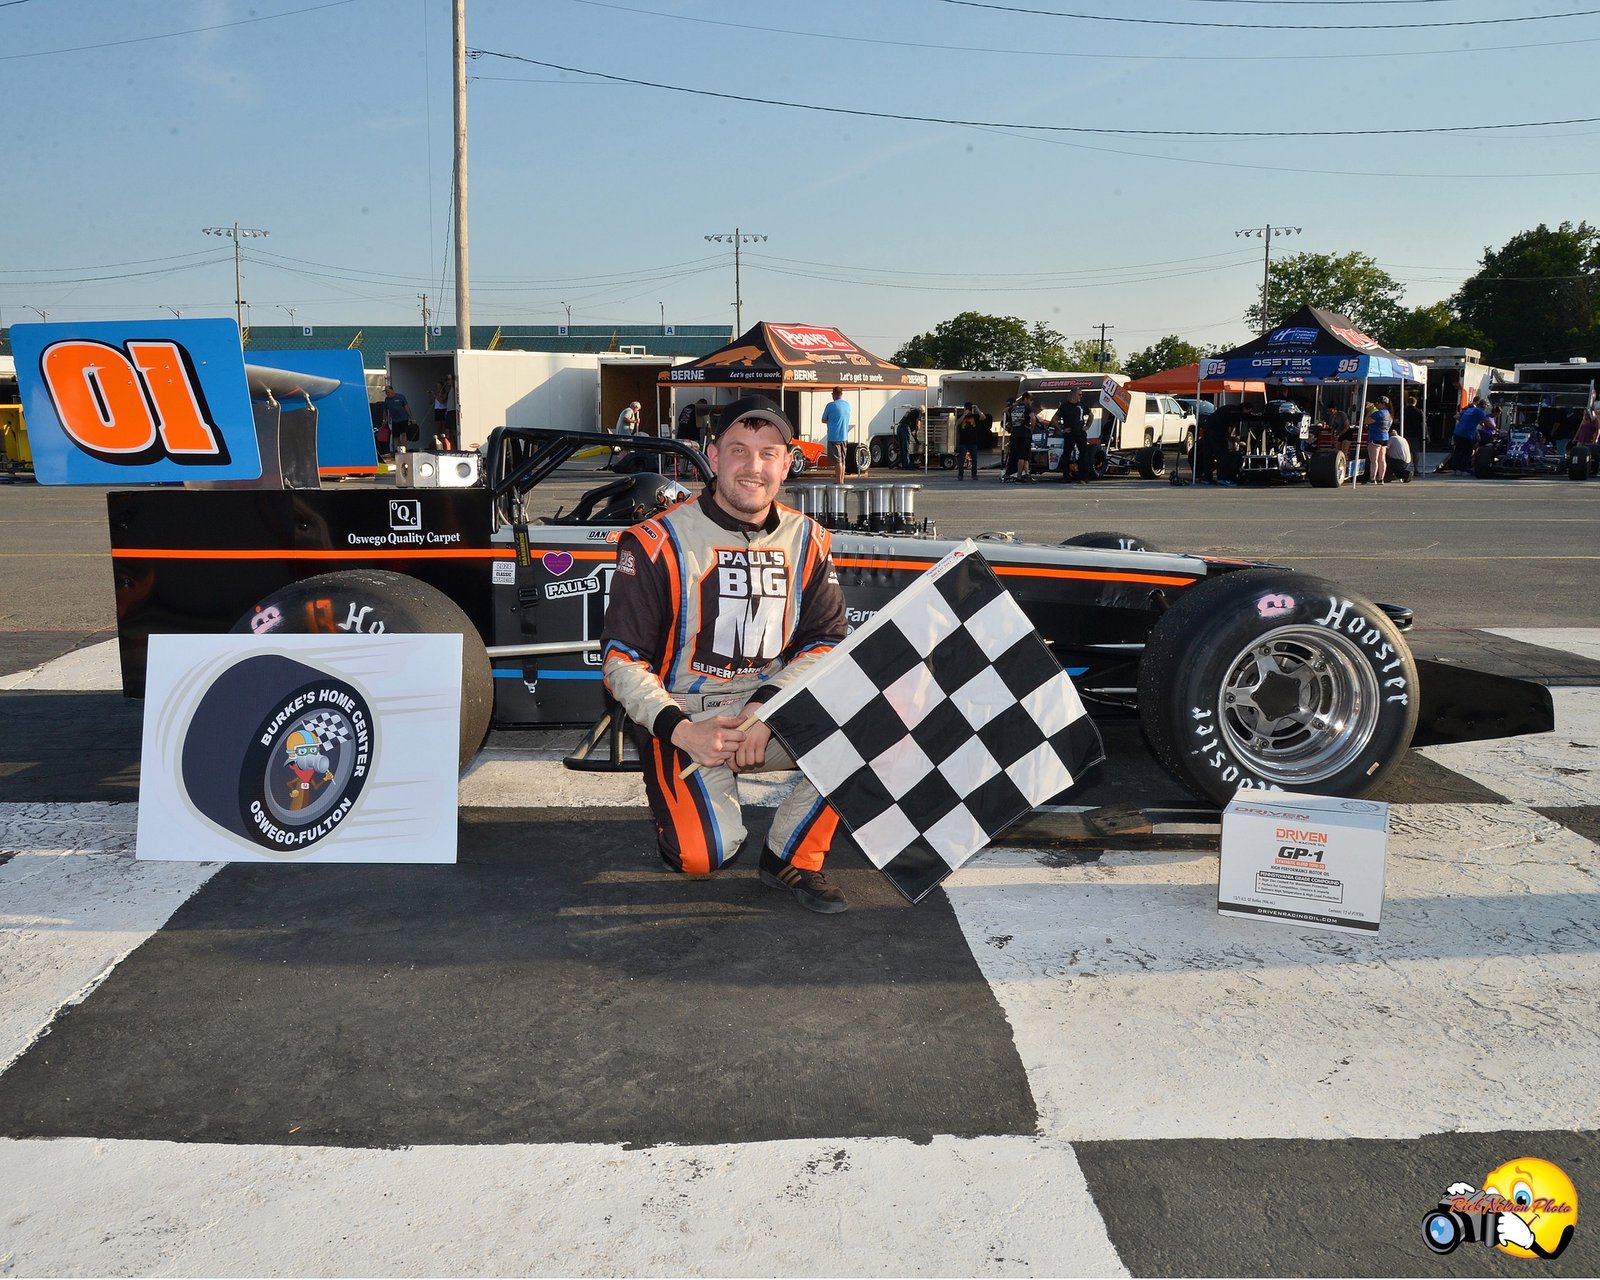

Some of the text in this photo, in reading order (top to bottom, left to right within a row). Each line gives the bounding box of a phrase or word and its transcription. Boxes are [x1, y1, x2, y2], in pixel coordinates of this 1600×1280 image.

[304, 327, 311, 335] D
[434, 327, 440, 335] C
[560, 327, 566, 335] B
[666, 327, 673, 335] A
[1208, 362, 1226, 375] 95
[1252, 358, 1312, 366] OSETEK
[1337, 359, 1359, 372] 95
[671, 370, 705, 380] BERNE
[793, 370, 818, 381] BERNE
[908, 374, 927, 384] BERNE
[41, 340, 221, 456] 01
[348, 532, 460, 545] Oswego Quality Carpet
[588, 530, 608, 538] DAN
[718, 551, 785, 566] PAUL'S
[548, 578, 597, 597] PAUL'S
[718, 567, 788, 597] BIG
[712, 597, 788, 659] M
[260, 689, 370, 778] BURKE'S HOME CENTER
[1235, 807, 1311, 820] DRIVEN
[250, 797, 352, 845] OSWEGO-FULTON
[1276, 828, 1328, 843] DRIVEN
[1278, 846, 1324, 862] GP-1
[1260, 872, 1294, 880] PENNSYLVANIA
[1311, 877, 1340, 886] COMPOUND
[1257, 908, 1338, 924] DRIVENRACINGOIL.COM
